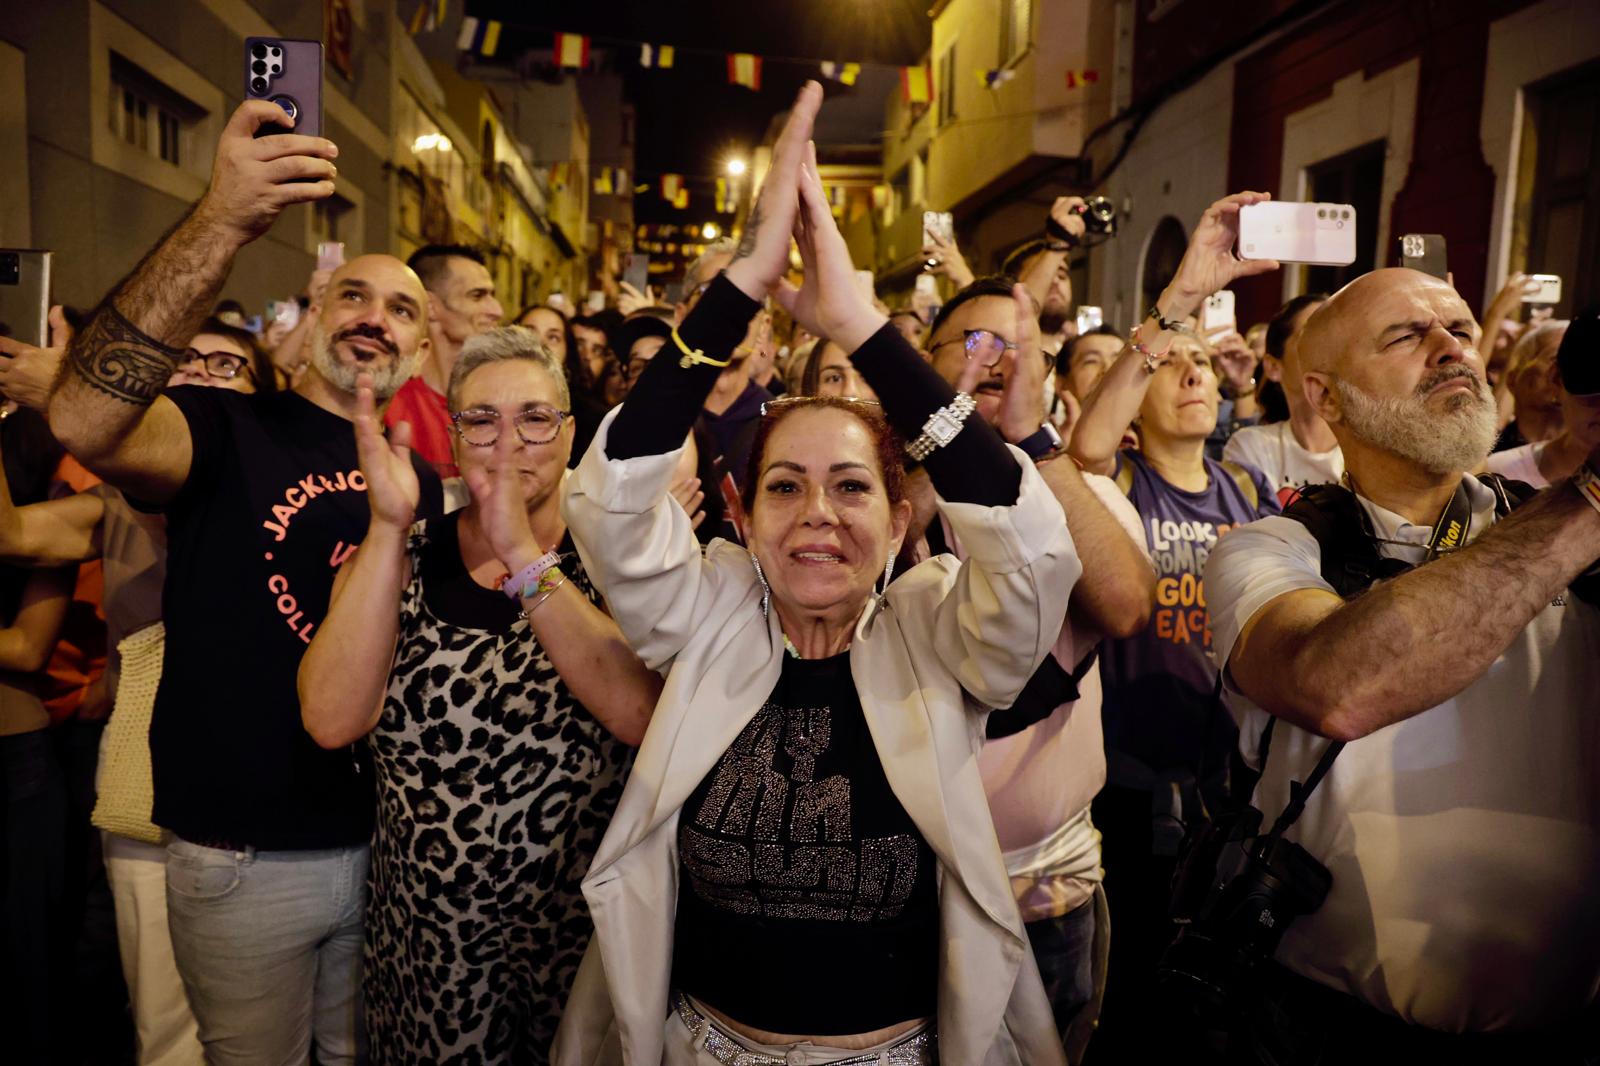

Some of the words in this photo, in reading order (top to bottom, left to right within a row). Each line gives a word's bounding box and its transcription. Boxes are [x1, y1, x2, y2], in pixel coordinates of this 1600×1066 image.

[1151, 517, 1218, 550] LOOK
[1439, 520, 1462, 548] ikon
[268, 574, 313, 643] COLL
